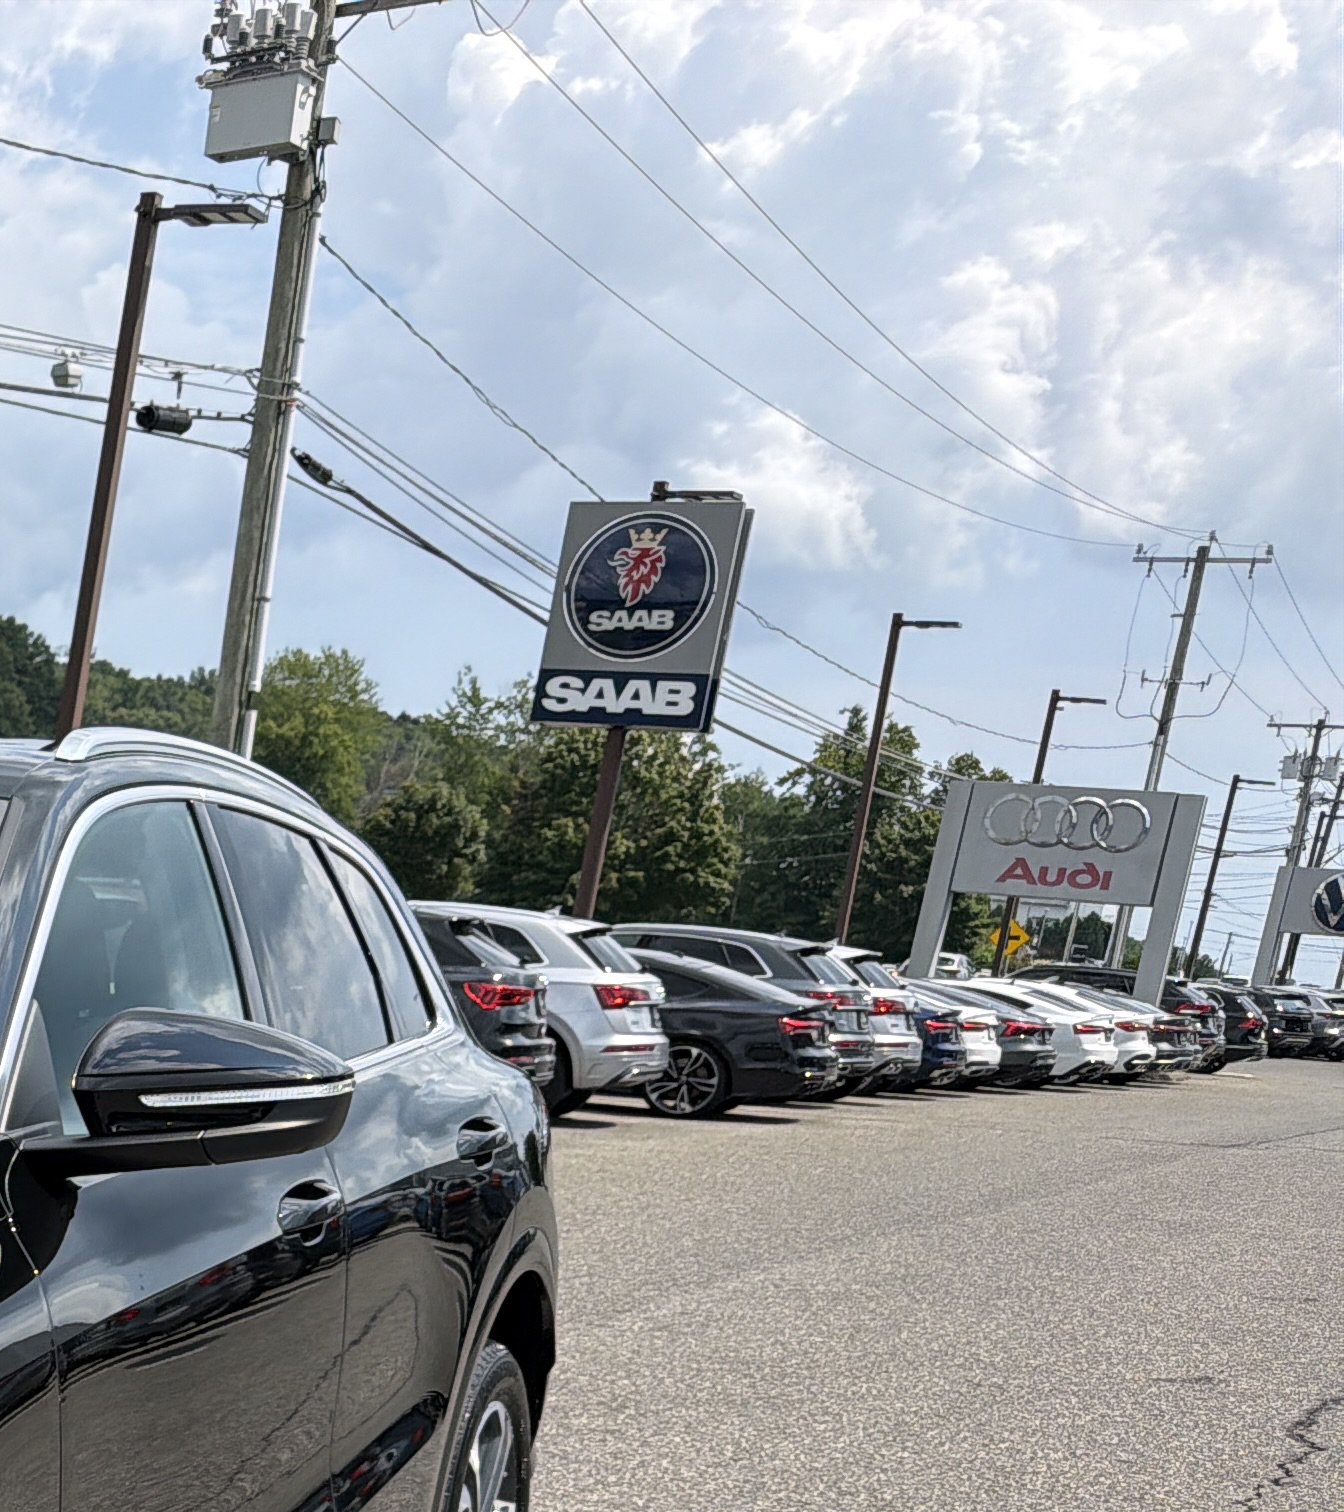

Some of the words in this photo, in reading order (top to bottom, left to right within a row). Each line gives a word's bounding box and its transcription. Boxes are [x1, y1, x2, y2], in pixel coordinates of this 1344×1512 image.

[587, 609, 675, 632] SAAB
[541, 675, 698, 717] SAAB
[995, 857, 1113, 891] Audi
